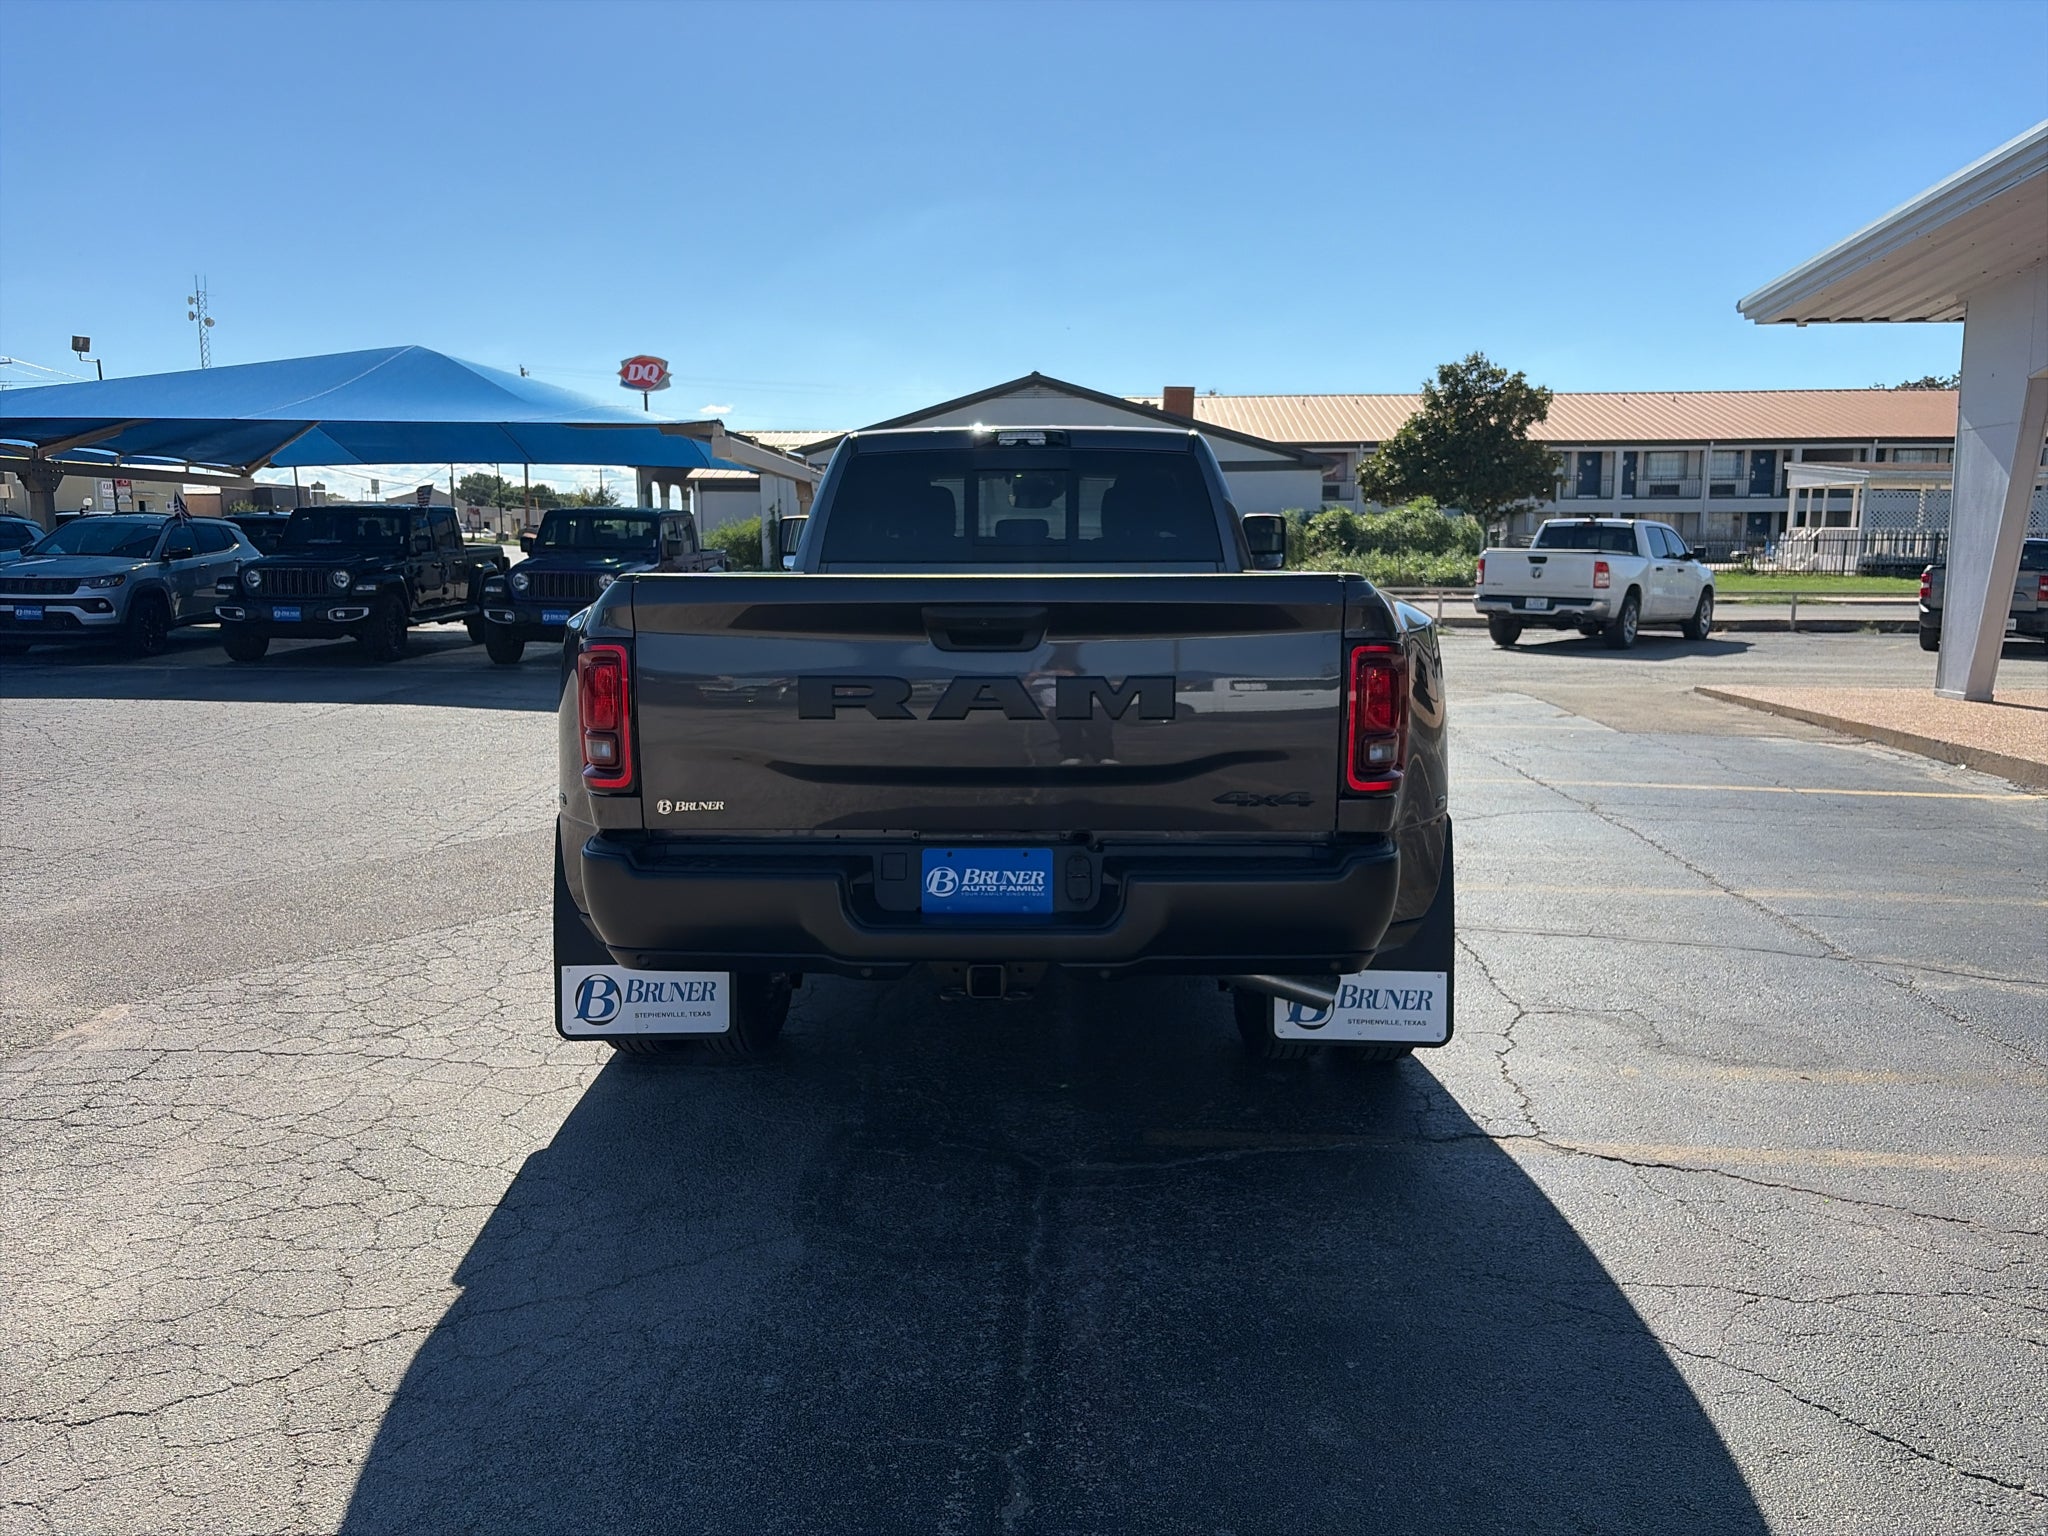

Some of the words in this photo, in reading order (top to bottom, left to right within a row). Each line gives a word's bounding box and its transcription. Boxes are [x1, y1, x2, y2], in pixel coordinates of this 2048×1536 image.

[627, 363, 659, 383] DQ
[799, 675, 1176, 720] RAM
[674, 801, 725, 812] BRUNER
[1211, 791, 1315, 807] 4x4
[927, 869, 955, 893] B
[961, 868, 1046, 885] BRUNER
[574, 978, 617, 1020] B
[624, 979, 717, 1004] BRUNER
[1337, 984, 1433, 1011] BRUNER
[634, 1011, 687, 1019] STEPHENVILLE,
[689, 1010, 712, 1018] TEXAS
[1347, 1018, 1401, 1026] STEPHENVILLE,
